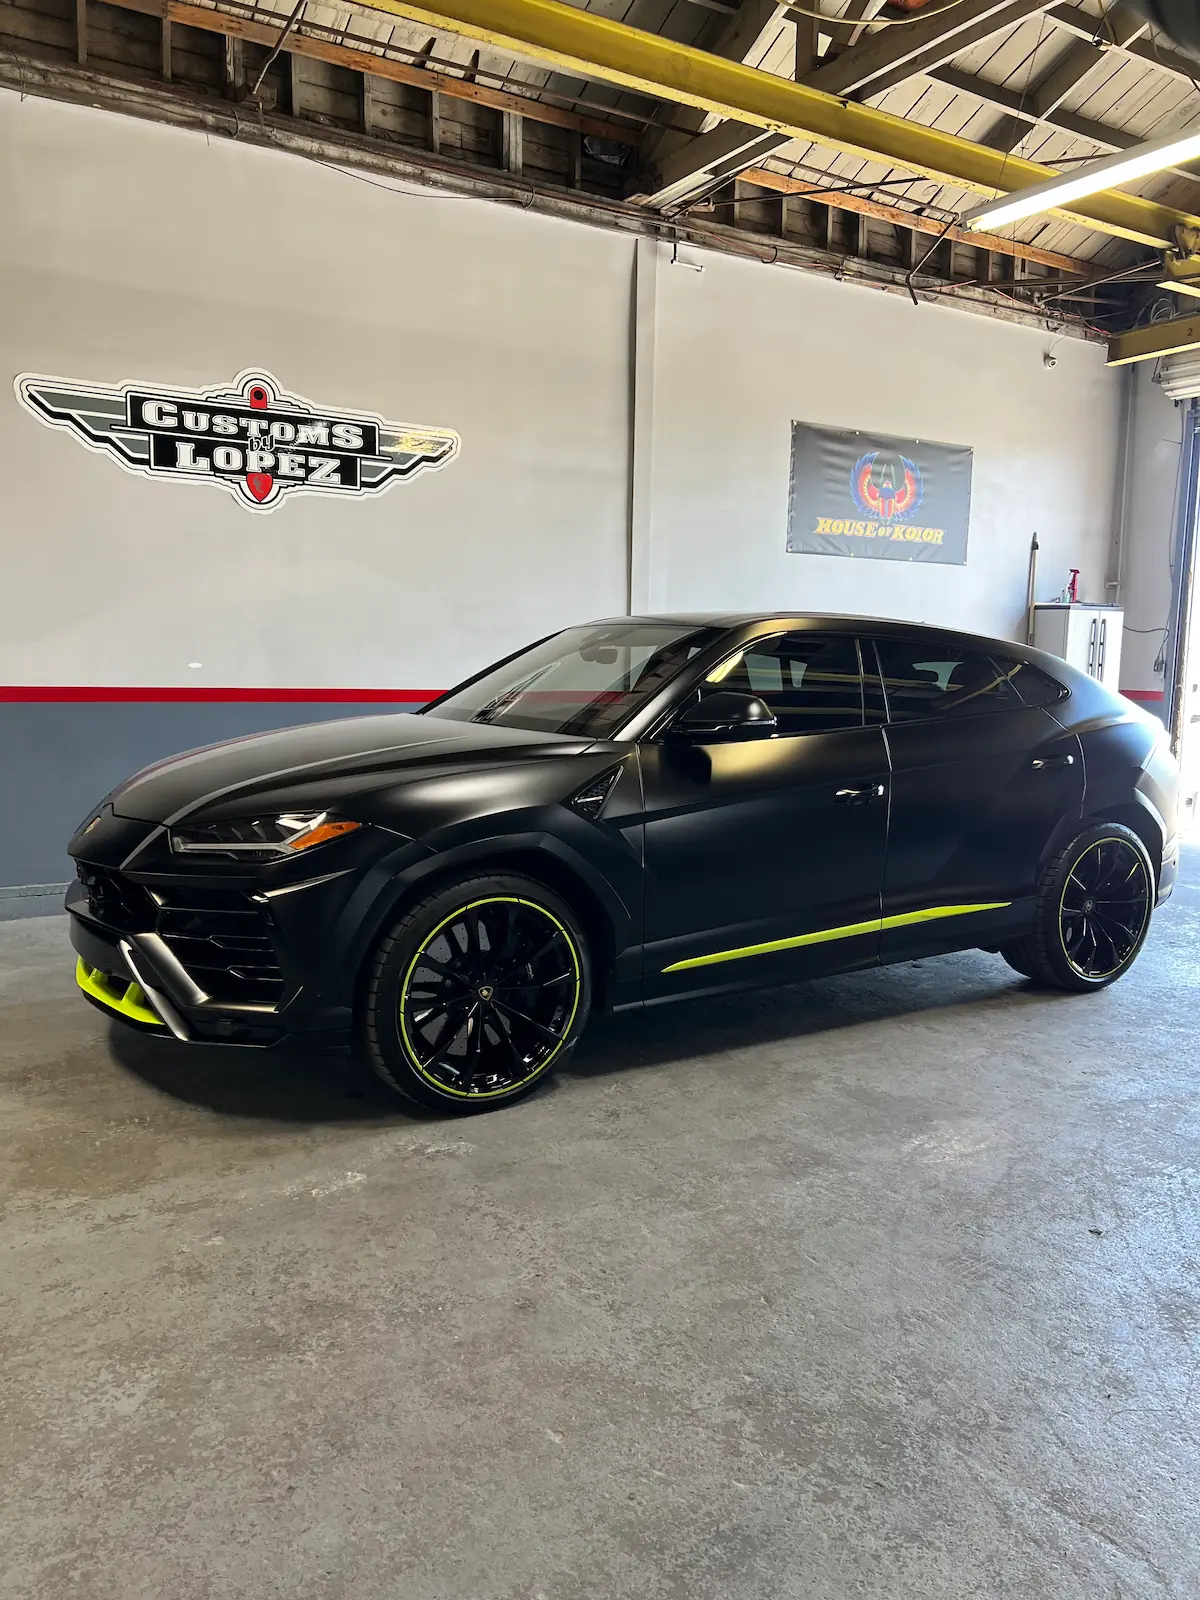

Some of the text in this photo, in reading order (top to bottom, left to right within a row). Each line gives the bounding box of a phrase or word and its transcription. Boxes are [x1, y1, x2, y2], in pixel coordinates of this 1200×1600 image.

[1187, 328, 1193, 337] 2
[142, 401, 365, 449] CUSTOMS
[248, 434, 276, 452] by
[175, 442, 342, 485] LOPEZ
[812, 516, 879, 539] HOUSE
[889, 524, 945, 545] KOLOR
